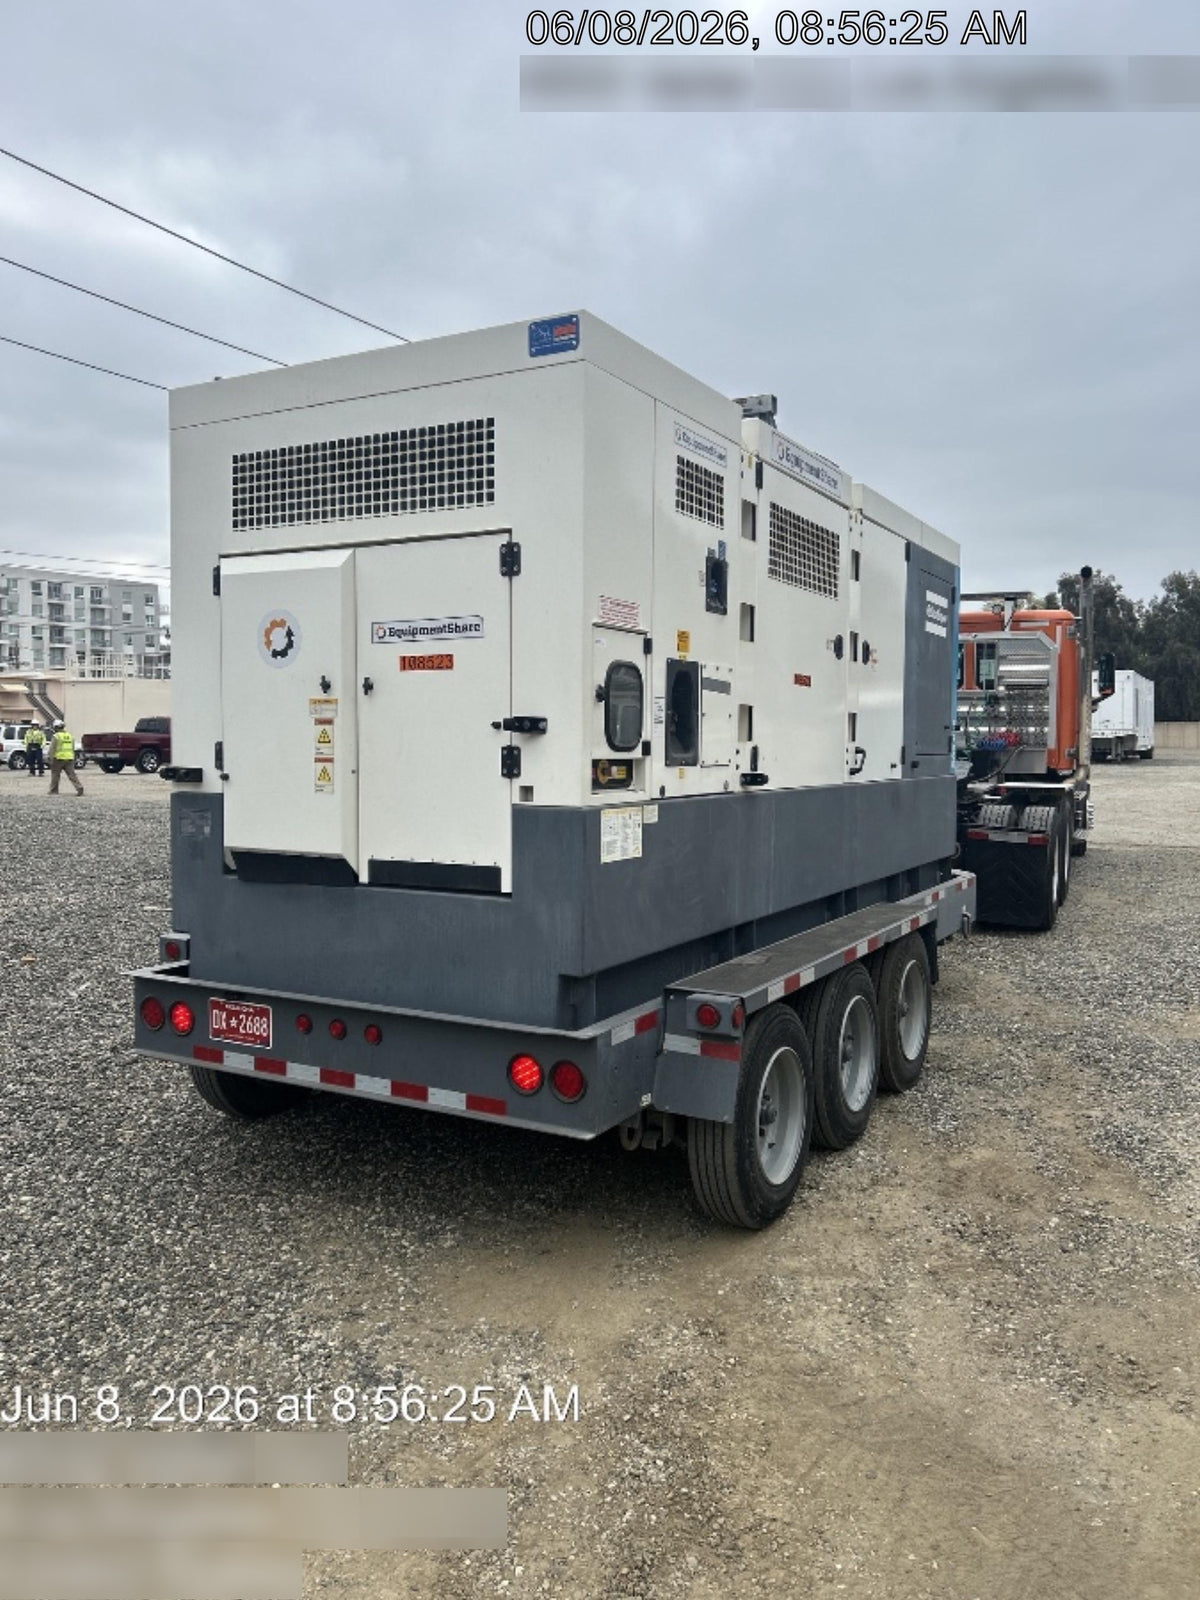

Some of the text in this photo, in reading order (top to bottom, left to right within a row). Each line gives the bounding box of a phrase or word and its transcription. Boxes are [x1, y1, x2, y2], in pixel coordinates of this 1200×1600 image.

[388, 623, 481, 639] EquipmentShare
[402, 655, 454, 671] 108523
[239, 1014, 269, 1037] 2688
